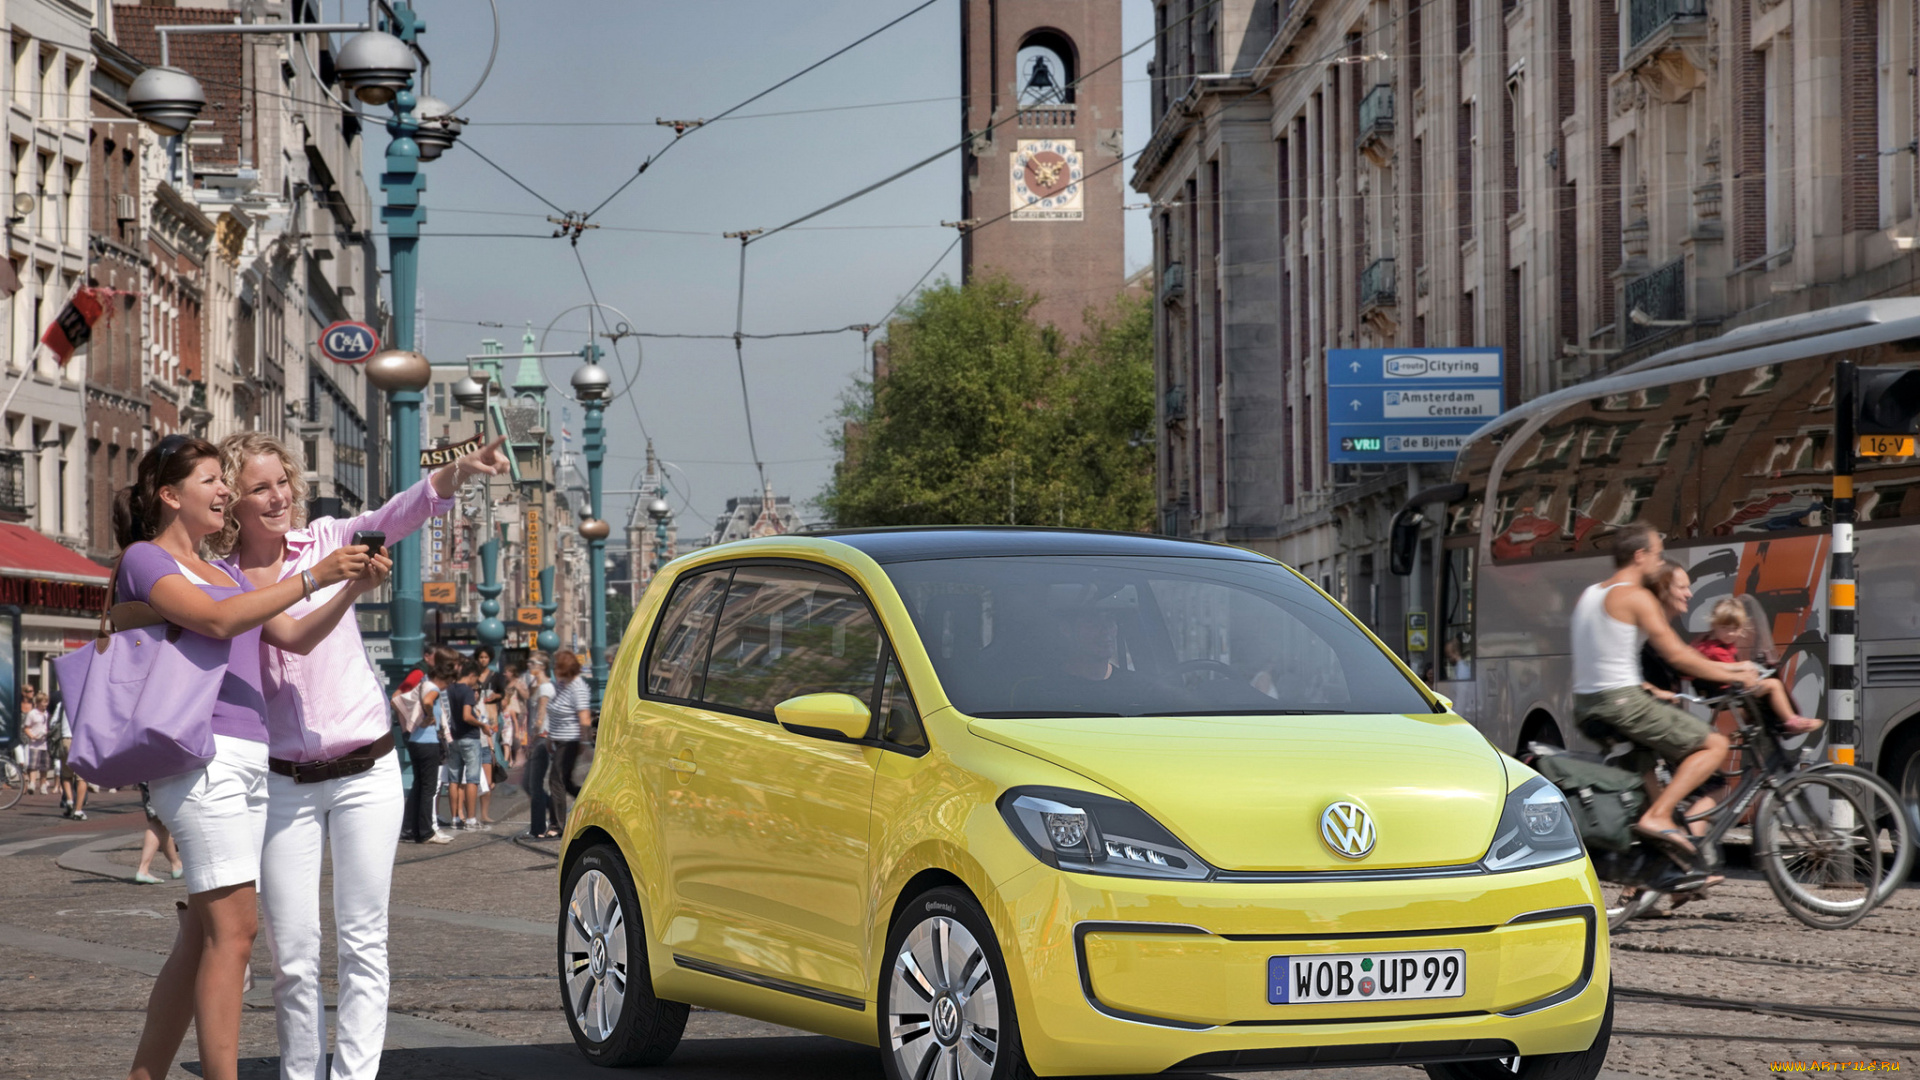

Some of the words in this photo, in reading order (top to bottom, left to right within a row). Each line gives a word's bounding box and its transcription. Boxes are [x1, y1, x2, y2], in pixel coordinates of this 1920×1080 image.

[329, 331, 368, 352] C&A
[1429, 360, 1479, 373] Cityring
[1402, 392, 1475, 403] Amsterdam
[1428, 405, 1482, 416] Centraal
[1354, 439, 1381, 450] VRIJ
[1403, 437, 1418, 448] de
[1870, 438, 1904, 452] 16-V
[434, 519, 442, 572] HOTEL
[1296, 961, 1354, 997] WOB
